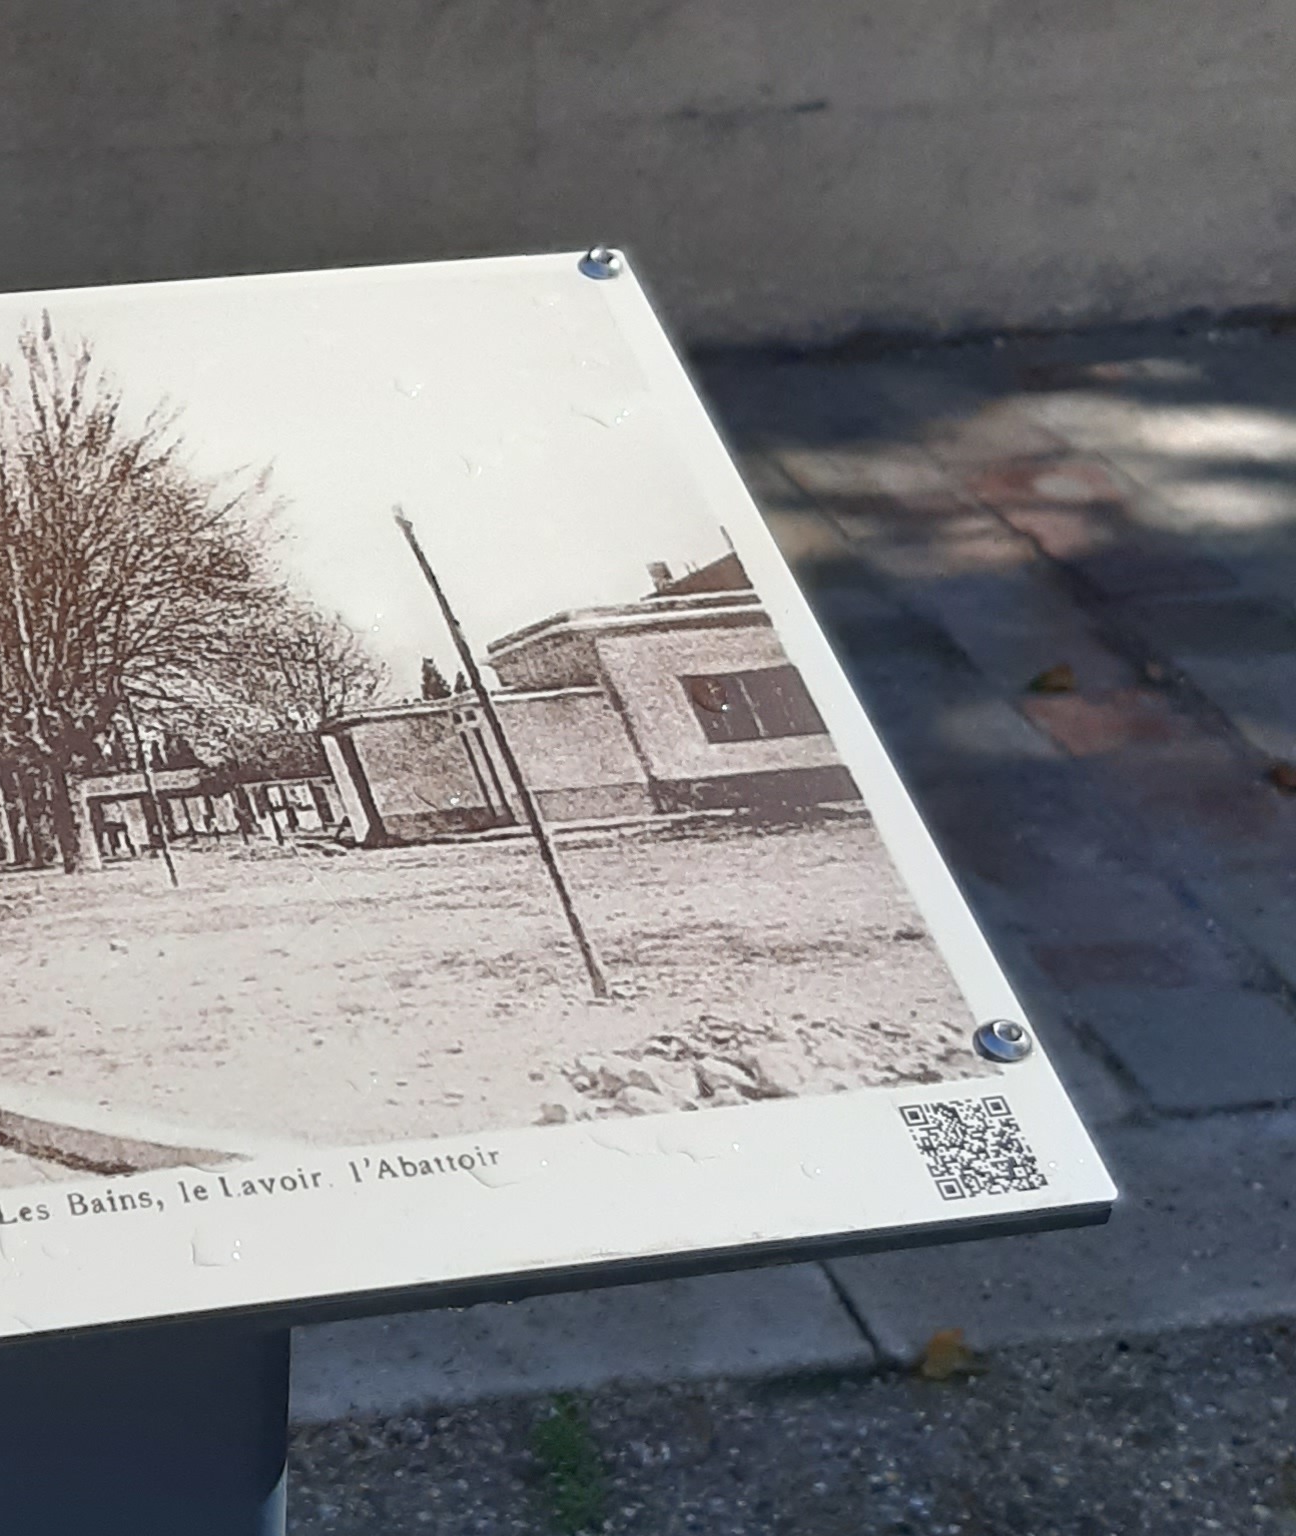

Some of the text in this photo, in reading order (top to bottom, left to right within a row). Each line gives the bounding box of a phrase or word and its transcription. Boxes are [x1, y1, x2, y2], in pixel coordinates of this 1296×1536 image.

[66, 1189, 165, 1216] Bains,
[177, 1180, 209, 1204] le
[347, 1146, 500, 1184] l'Abattoir
